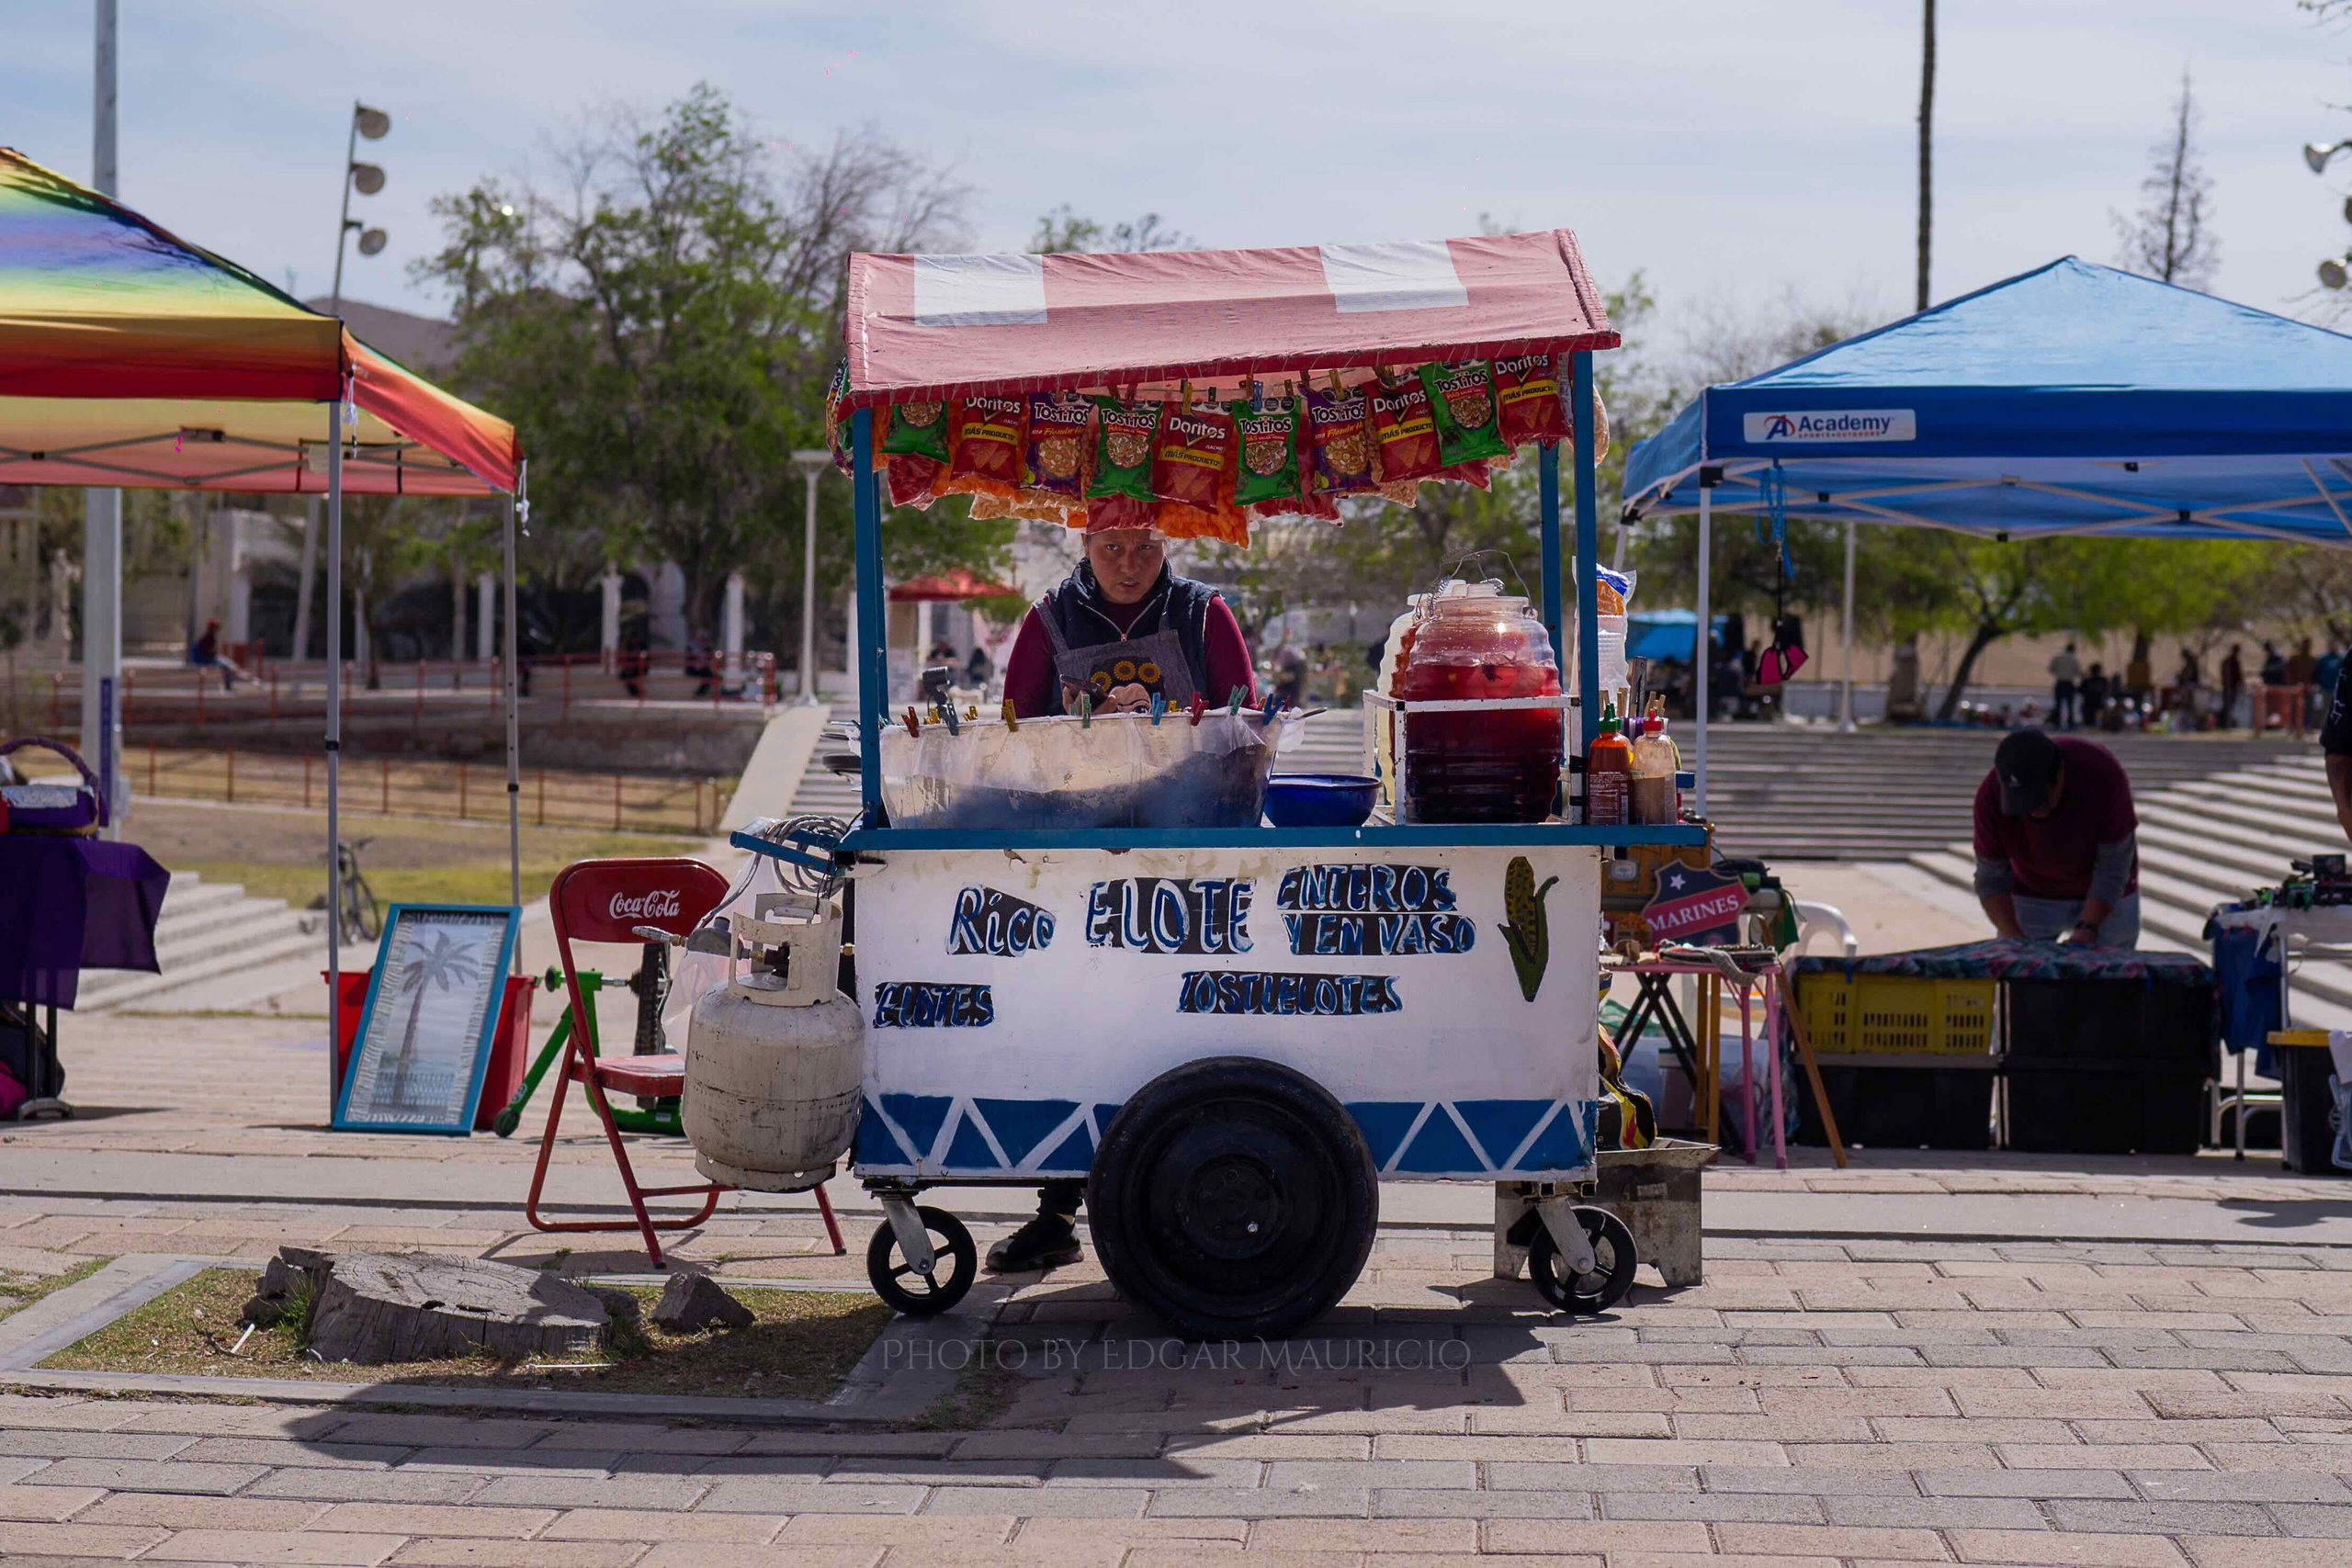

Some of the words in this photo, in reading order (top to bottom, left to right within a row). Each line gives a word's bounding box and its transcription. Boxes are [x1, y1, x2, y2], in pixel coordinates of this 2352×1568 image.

[1495, 355, 1549, 378] Doritos
[1374, 389, 1427, 413] Doritos
[1170, 417, 1226, 440] Doritos
[1798, 415, 1892, 434] Academy
[609, 889, 680, 919] Coca-Cola
[1277, 864, 1457, 911] ENTEROS
[1085, 877, 1257, 954] ELOTE
[1646, 894, 1739, 931] MARINES
[1283, 914, 1302, 955] Y
[1315, 914, 1363, 955] EN
[1378, 913, 1477, 955] VASO
[875, 983, 995, 1028] ELOTES
